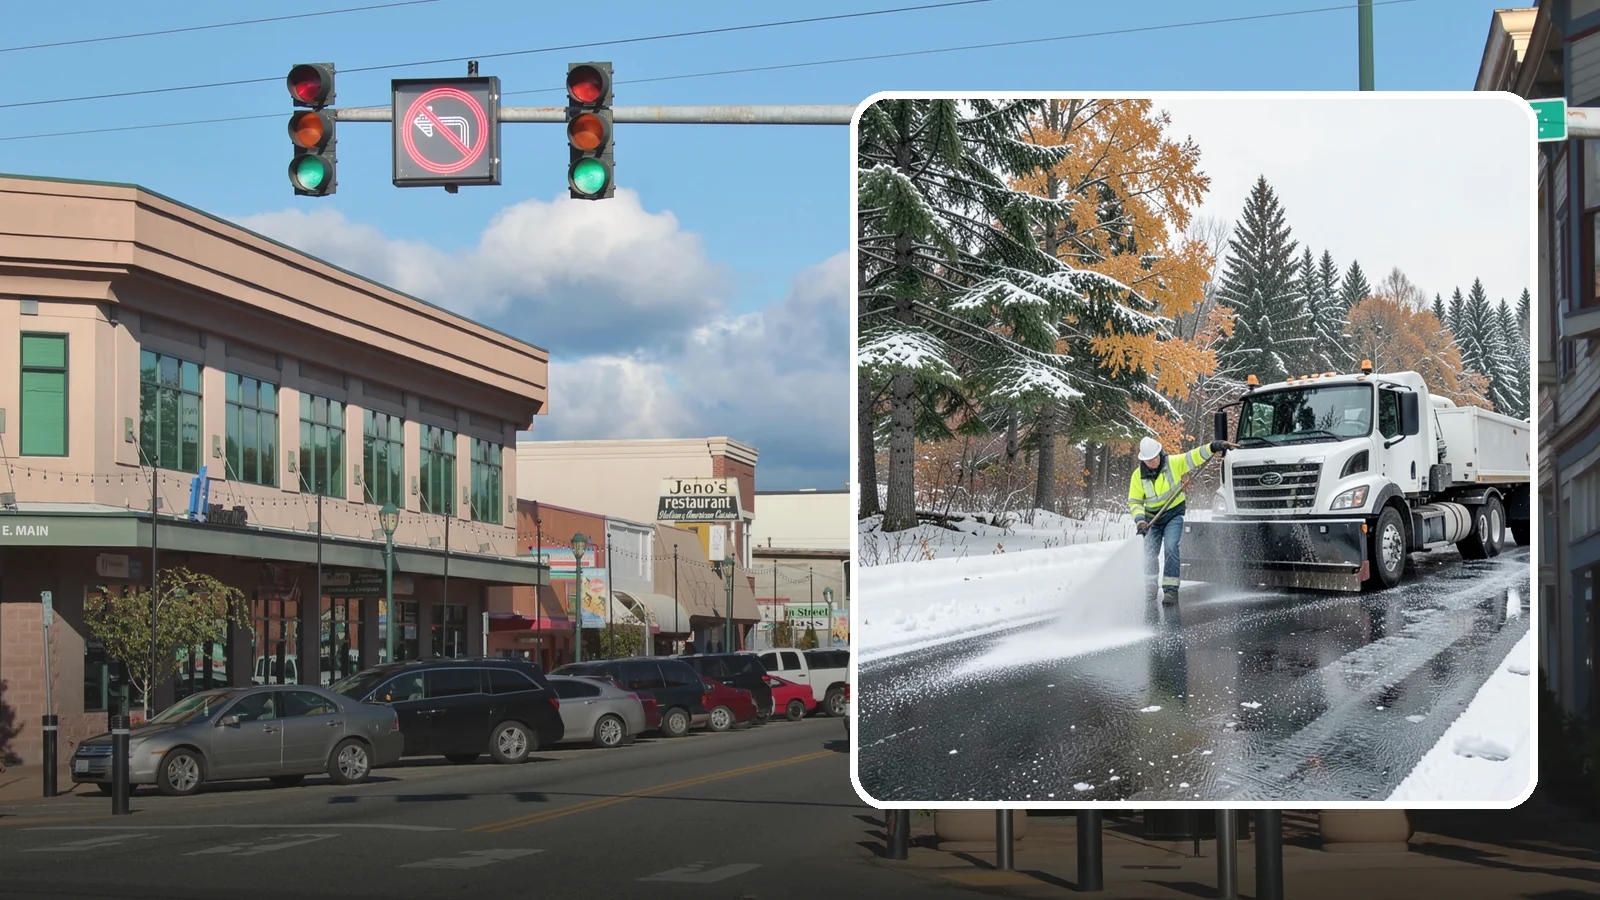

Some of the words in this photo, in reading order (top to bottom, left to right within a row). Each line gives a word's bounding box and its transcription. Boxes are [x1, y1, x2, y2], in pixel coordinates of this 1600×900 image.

[670, 480, 727, 494] Jeno's
[665, 496, 731, 509] restaurant
[658, 510, 681, 520] Italian
[686, 510, 714, 519] American
[715, 510, 738, 519] Cuisine
[2, 525, 13, 536] E.
[15, 525, 49, 536] MAIN
[797, 608, 829, 617] Street
[789, 619, 824, 627] lass
